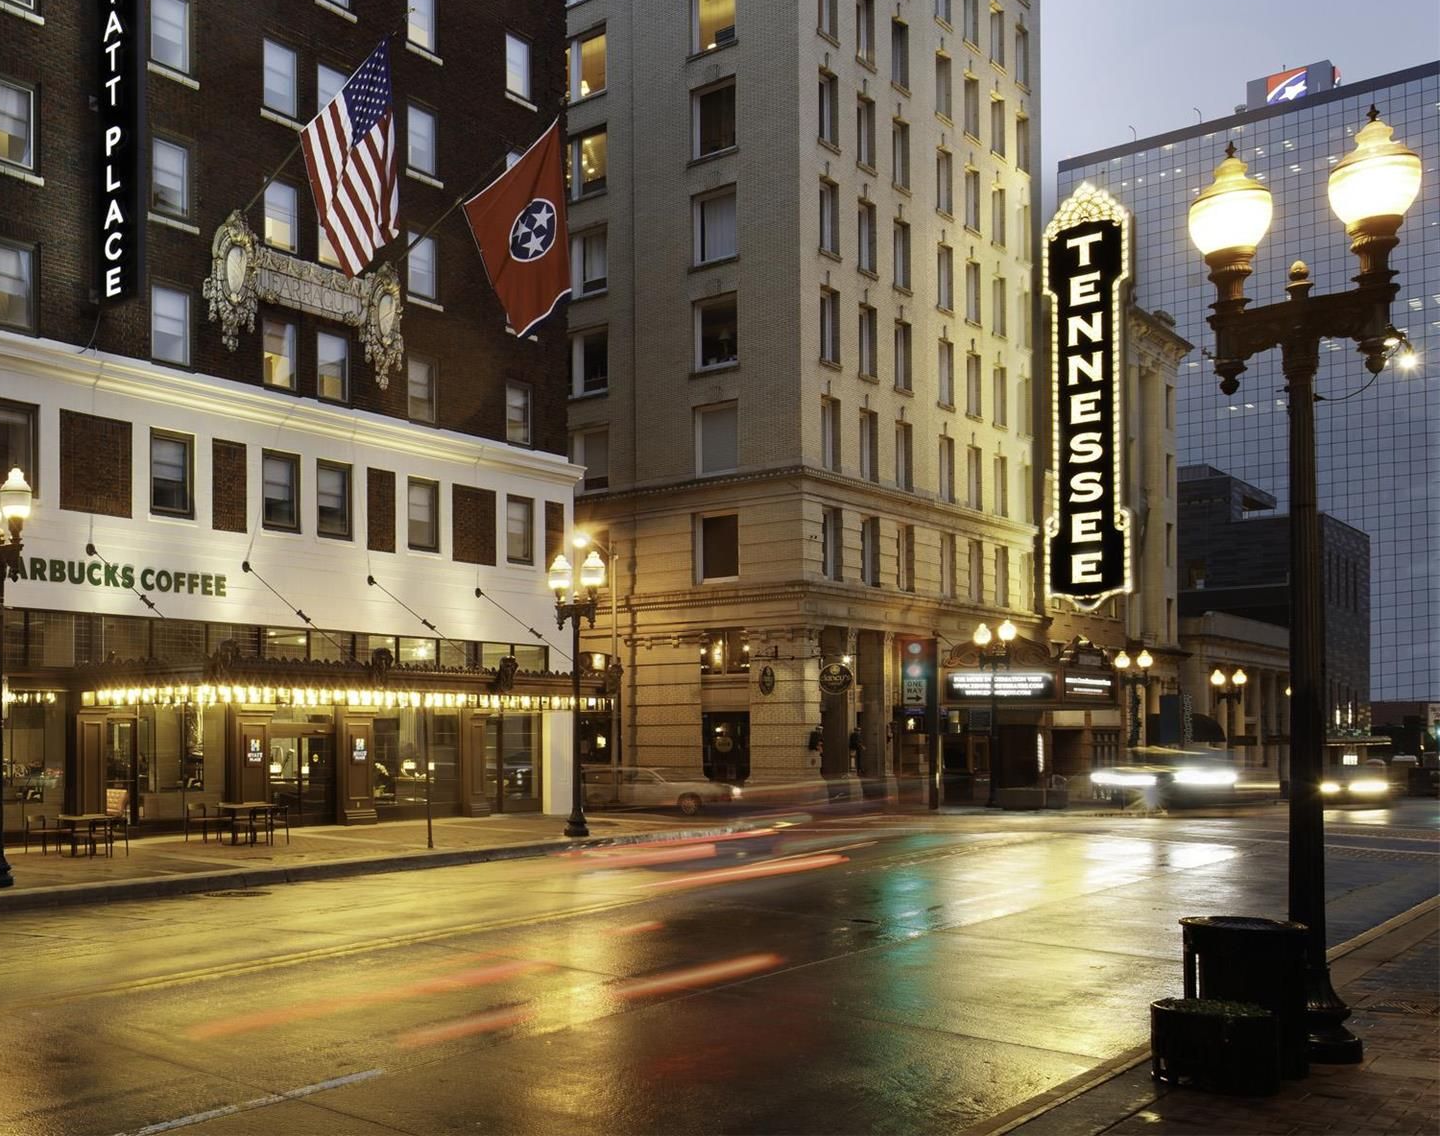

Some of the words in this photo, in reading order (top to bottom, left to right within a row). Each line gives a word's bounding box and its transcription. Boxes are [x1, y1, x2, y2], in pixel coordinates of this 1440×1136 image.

[103, 125, 124, 298] PLACE
[1066, 231, 1104, 584] TENNESSEE
[140, 568, 227, 597] COFFEE
